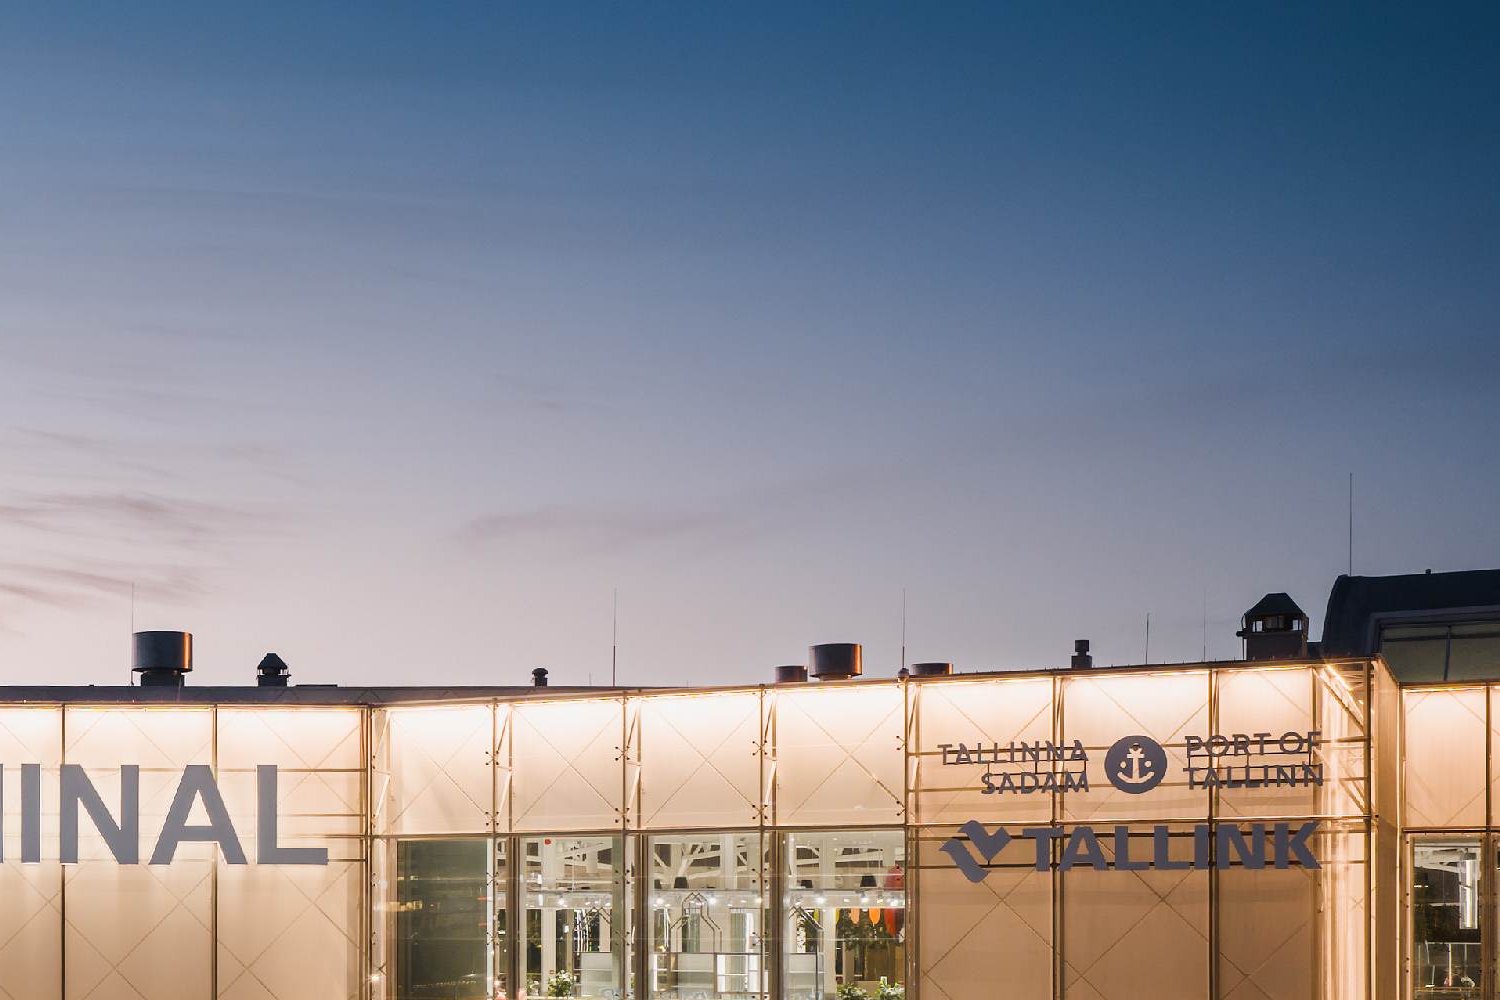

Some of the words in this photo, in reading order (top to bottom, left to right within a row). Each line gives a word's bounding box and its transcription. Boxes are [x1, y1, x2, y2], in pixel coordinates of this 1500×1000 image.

[937, 739, 1089, 766] TALLINNA
[1184, 732, 1271, 758] PORT
[1279, 731, 1323, 755] OF
[981, 771, 1090, 795] SADAM
[1183, 763, 1324, 790] TALLINN
[1023, 821, 1323, 872] TALLINK
